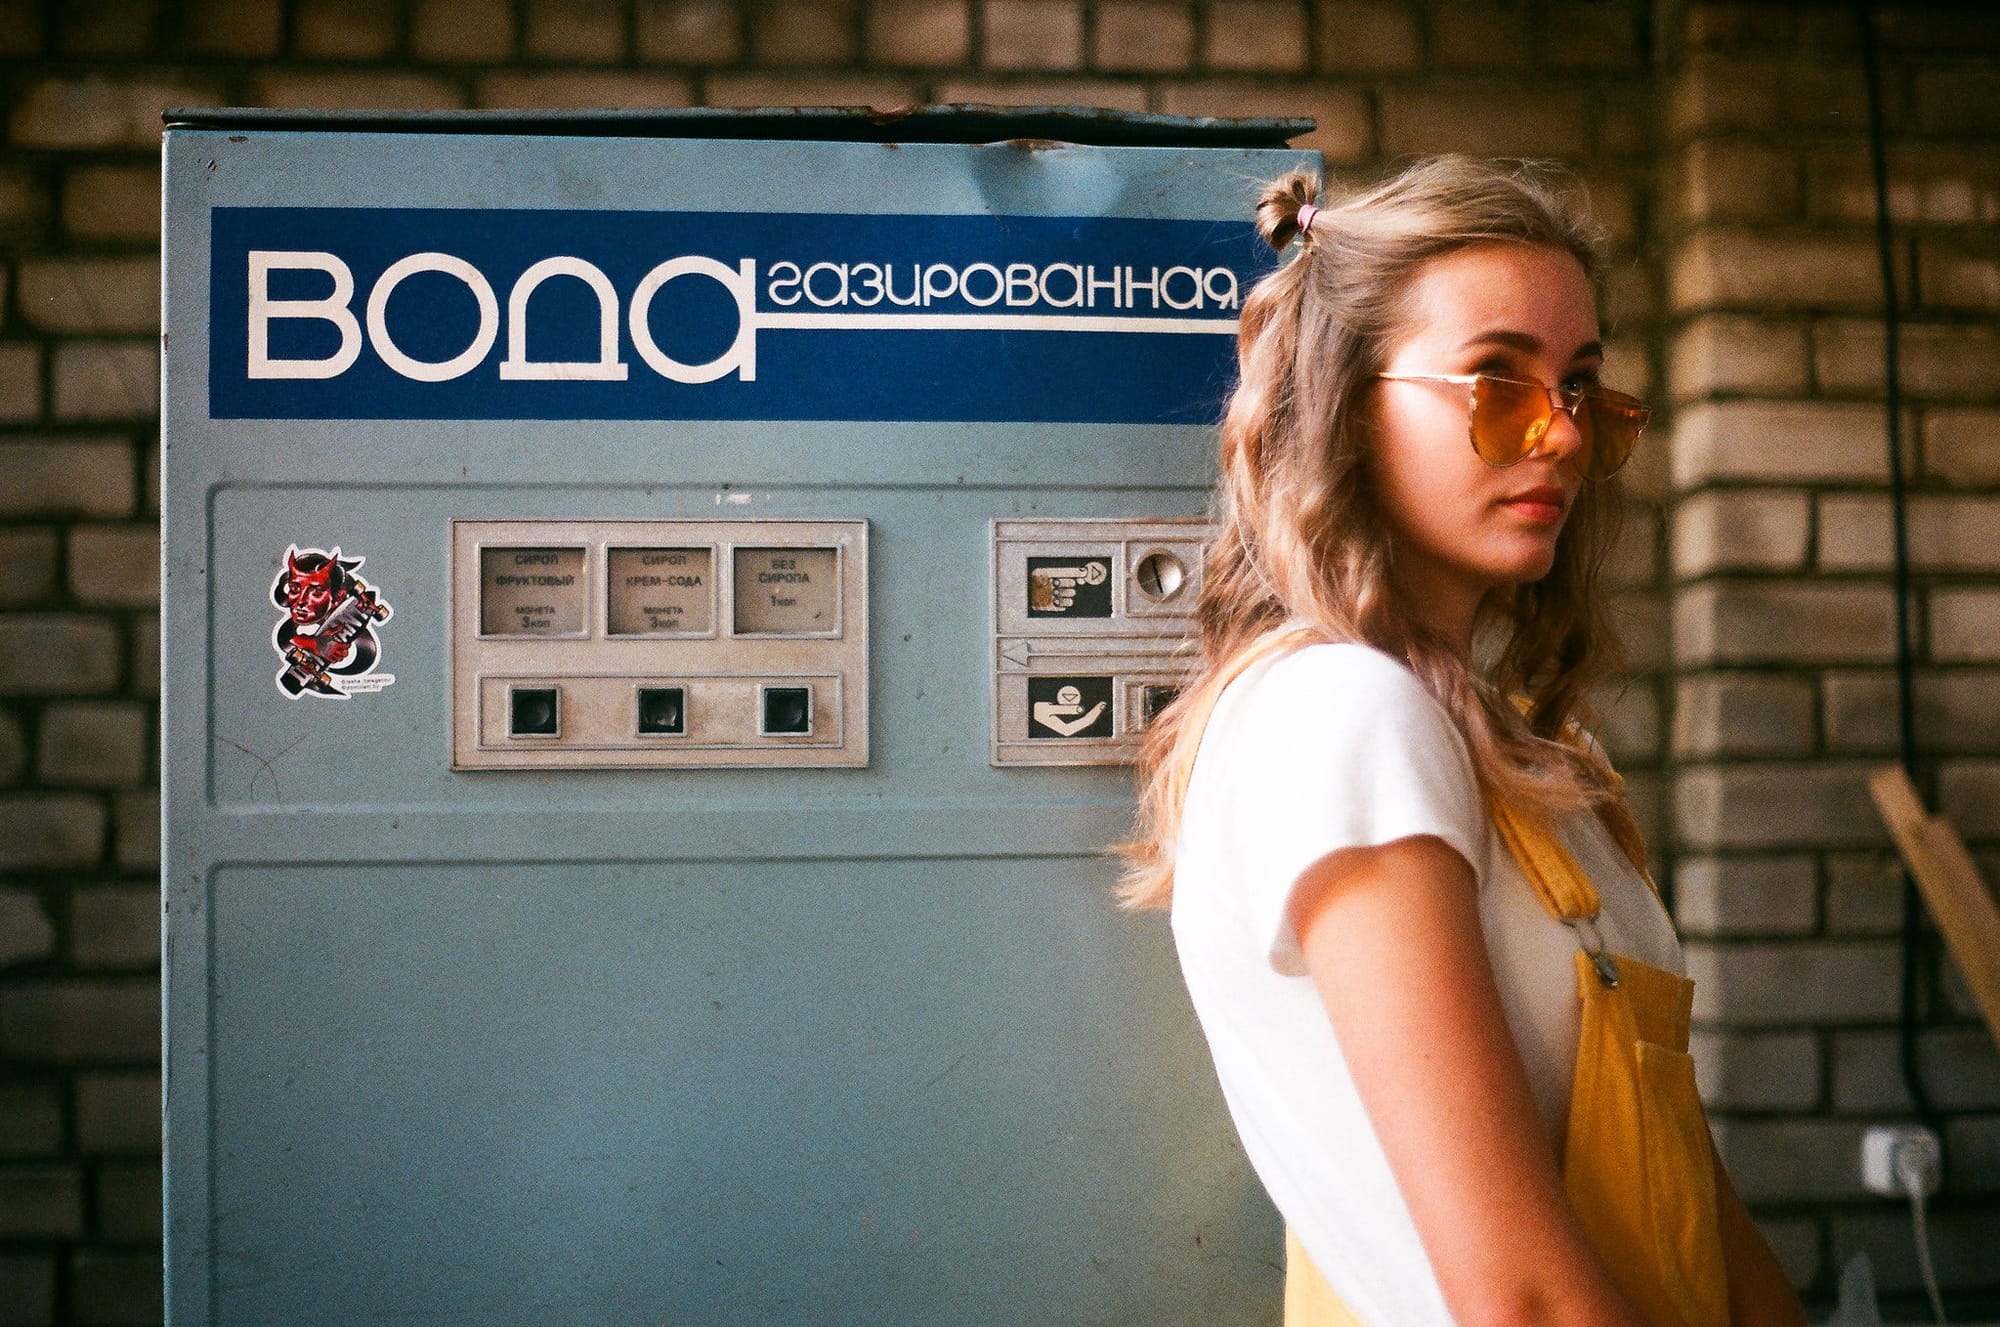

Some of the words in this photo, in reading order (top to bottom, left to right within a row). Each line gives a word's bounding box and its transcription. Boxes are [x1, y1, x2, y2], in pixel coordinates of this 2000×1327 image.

[642, 554, 688, 566] СИРОП
[771, 559, 796, 570] БЕЗ
[758, 572, 810, 584] СИРОПА
[643, 605, 684, 615] МОНЕТА
